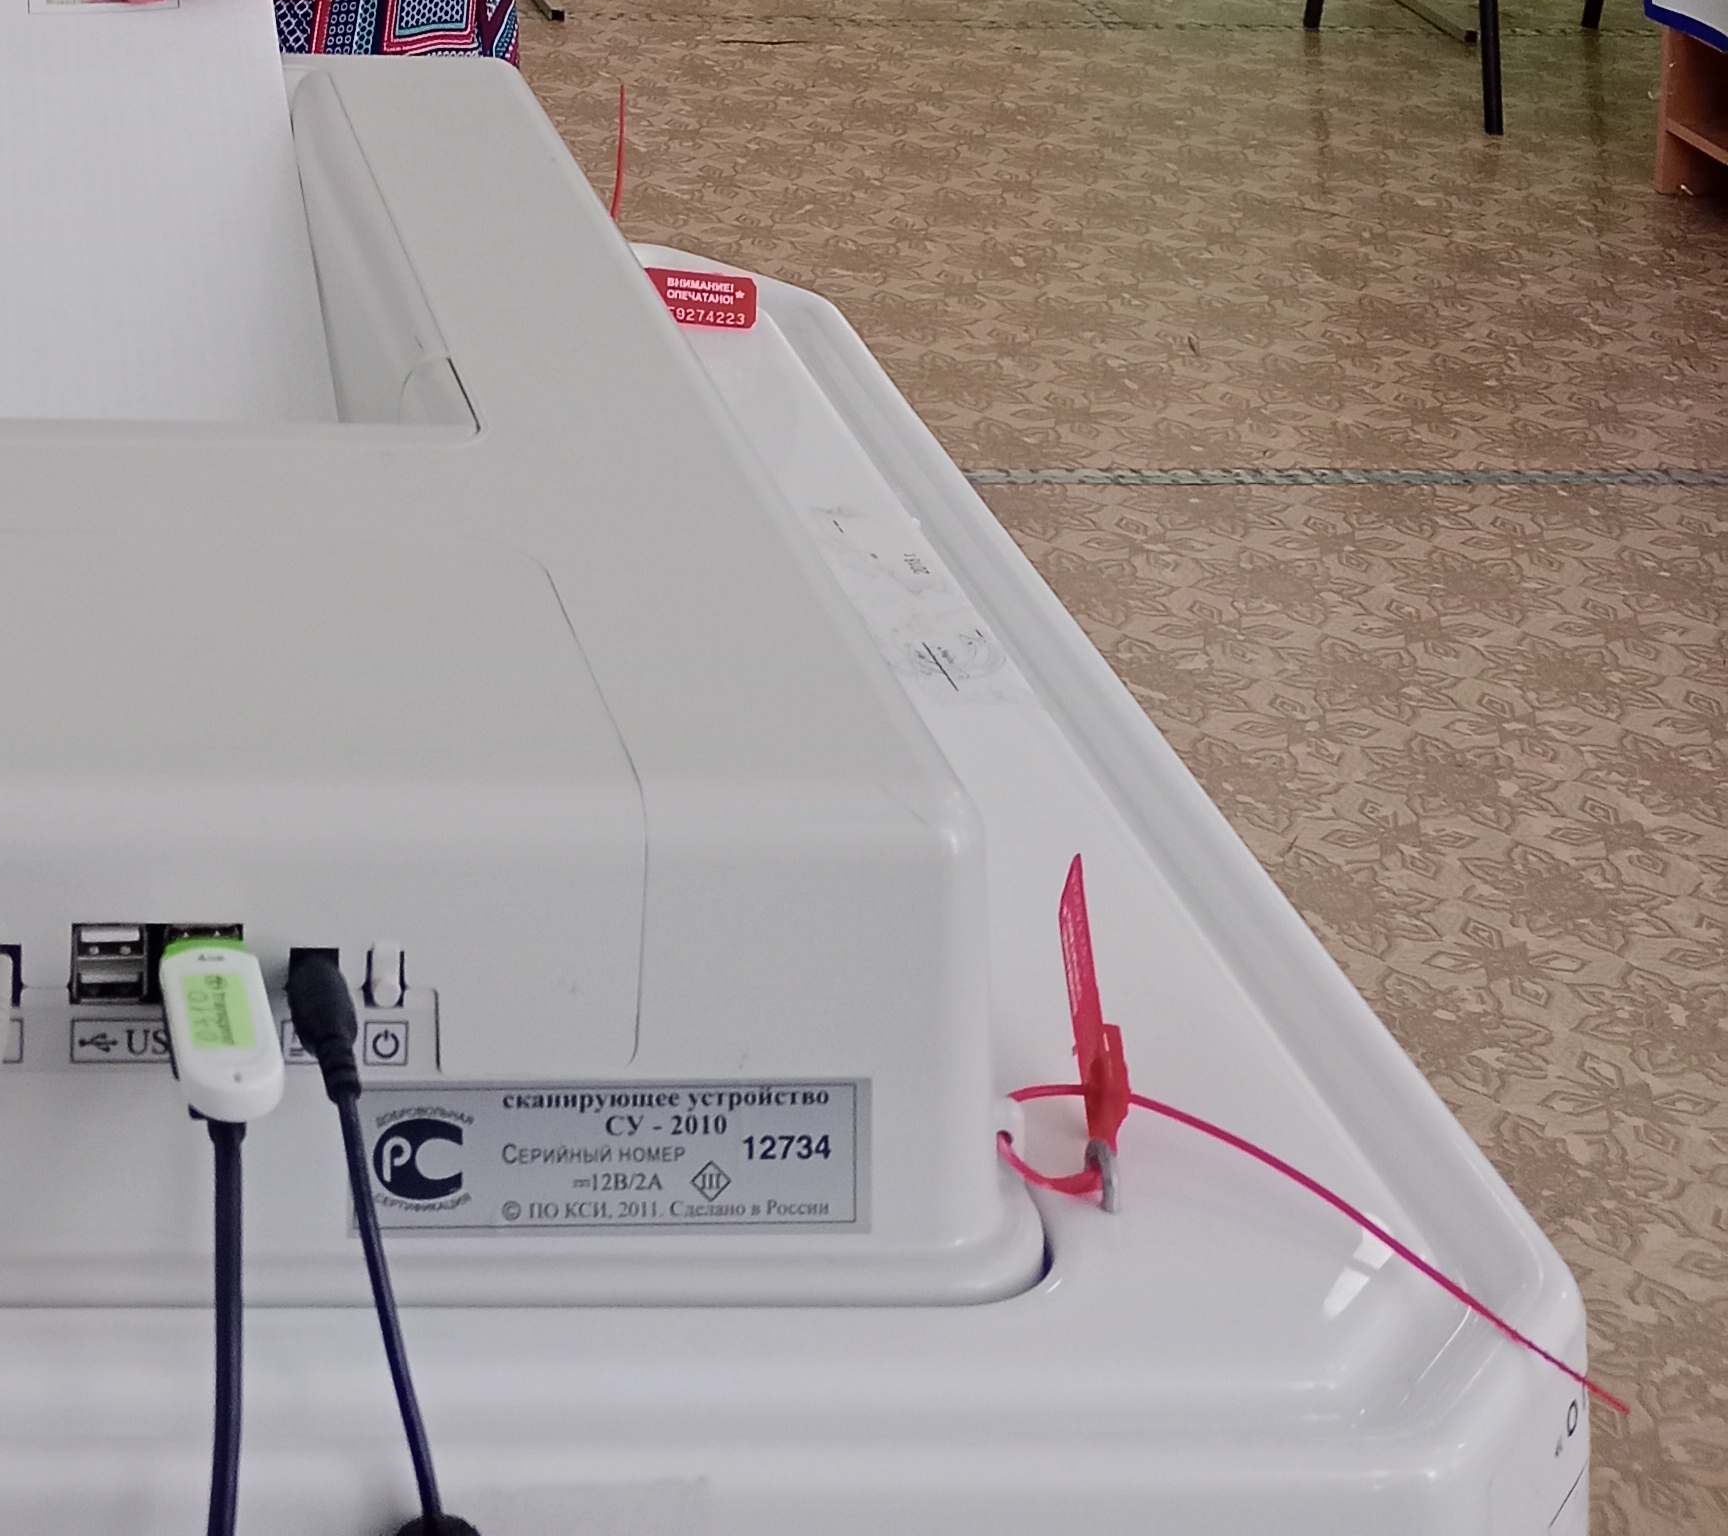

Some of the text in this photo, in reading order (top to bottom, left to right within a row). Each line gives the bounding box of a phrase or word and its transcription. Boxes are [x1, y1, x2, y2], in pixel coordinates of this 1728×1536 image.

[667, 276, 734, 293] ВНИМАНИЕ!
[666, 288, 734, 305] ОПЕЧАТАНО!
[502, 1085, 830, 1114] сканирующее устройство
[605, 1114, 645, 1136] СУ
[671, 1114, 728, 1135] 2010
[742, 1134, 832, 1160] 12734
[528, 1202, 560, 1219] ПО
[669, 1199, 746, 1218] Сделано
[751, 1205, 761, 1216] в
[766, 1199, 830, 1216] России
